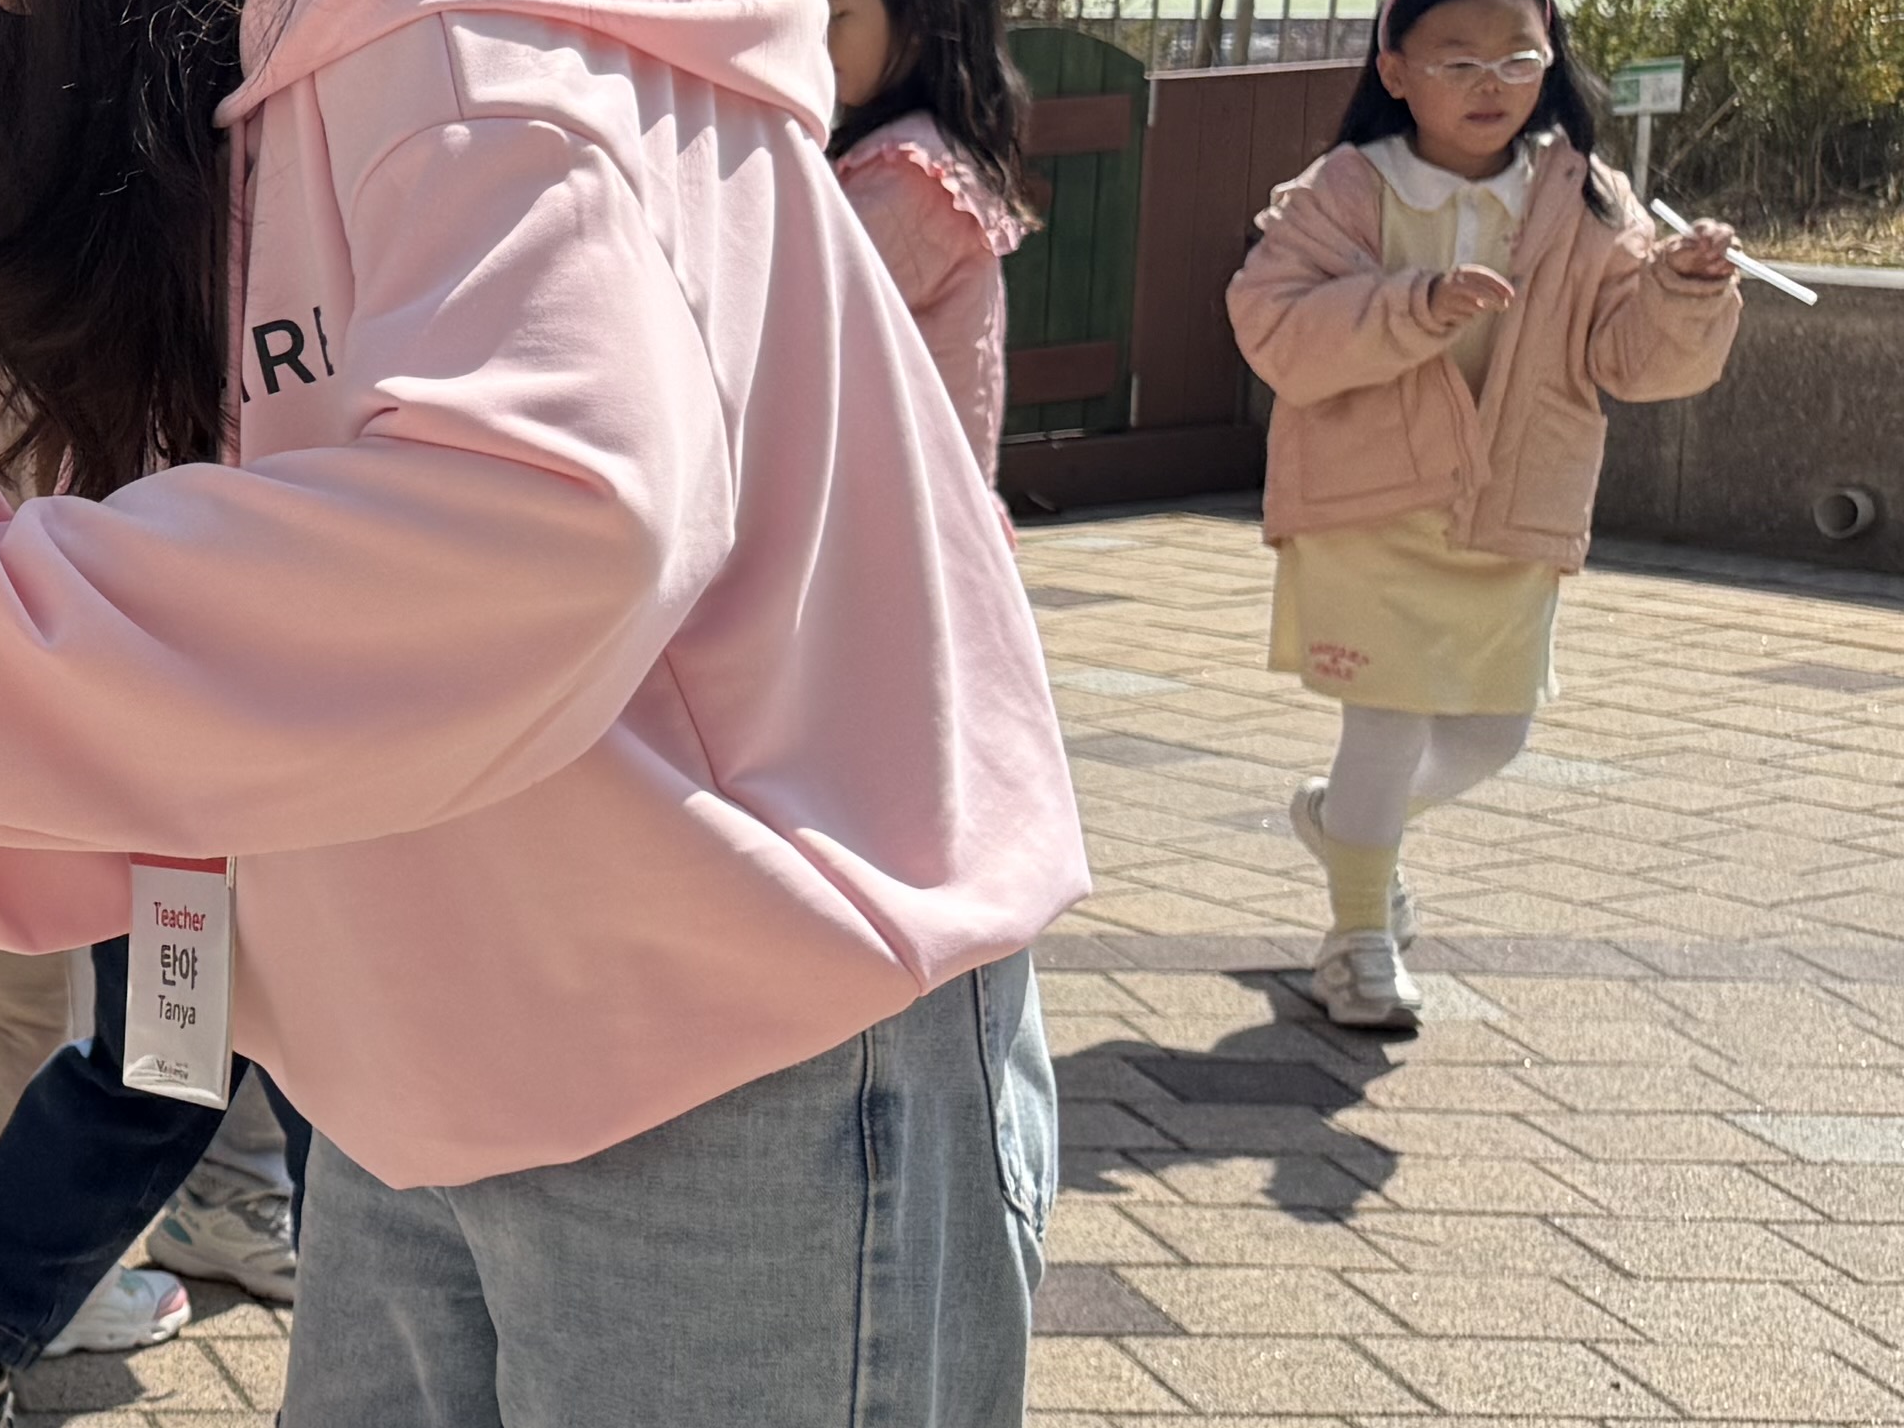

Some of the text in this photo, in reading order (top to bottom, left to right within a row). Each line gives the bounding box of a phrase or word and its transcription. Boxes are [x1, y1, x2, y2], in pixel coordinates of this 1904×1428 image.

[153, 901, 207, 932] Teacher
[160, 944, 199, 990] 탄야
[158, 995, 197, 1030] Tanya
